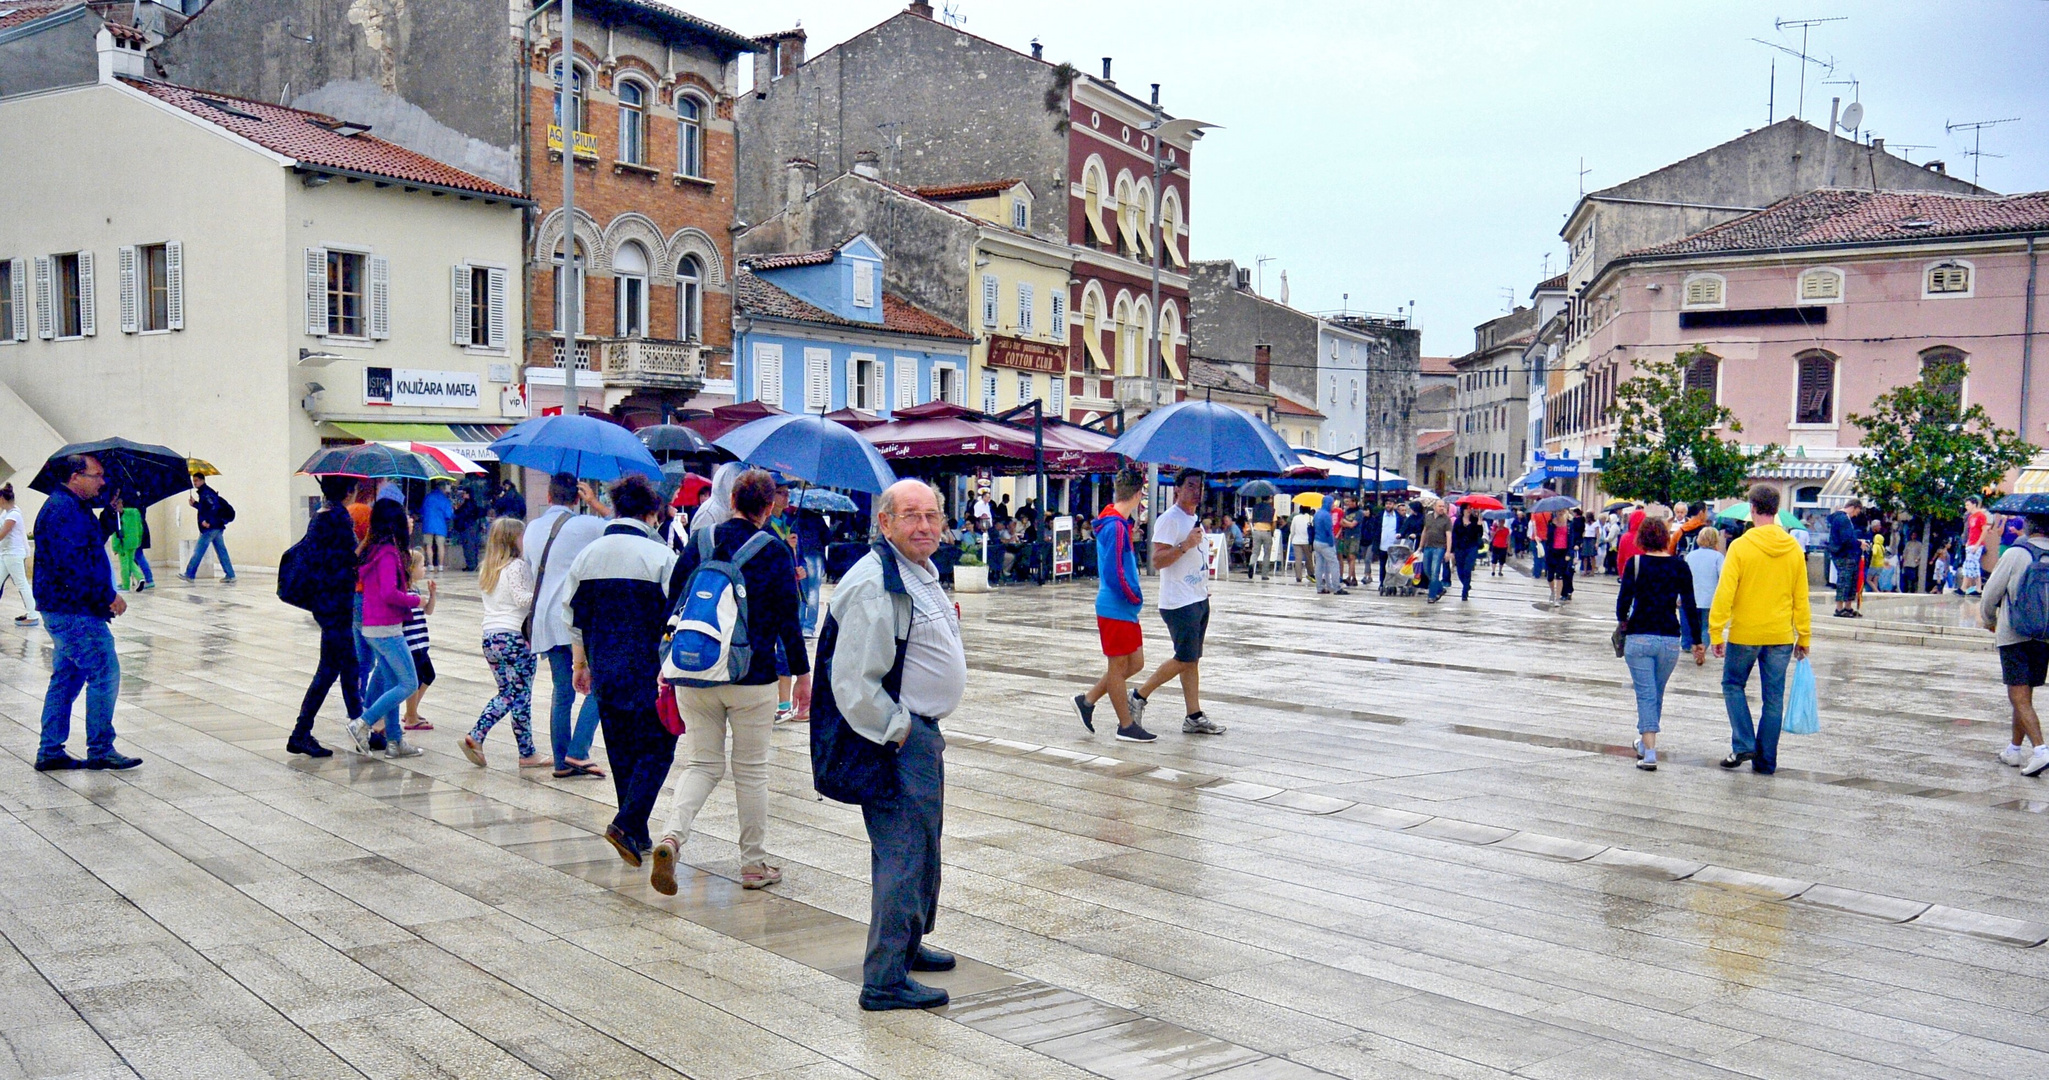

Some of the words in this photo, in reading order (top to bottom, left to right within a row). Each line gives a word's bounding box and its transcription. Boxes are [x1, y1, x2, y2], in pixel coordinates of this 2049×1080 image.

[549, 127, 597, 150] AQRIUM
[1005, 351, 1033, 367] COTTON
[1035, 356, 1053, 370] CLUB
[397, 378, 444, 396] KNJIŽARA
[446, 382, 477, 397] MATEA
[509, 396, 521, 408] vip
[1553, 464, 1577, 472] mlinar
